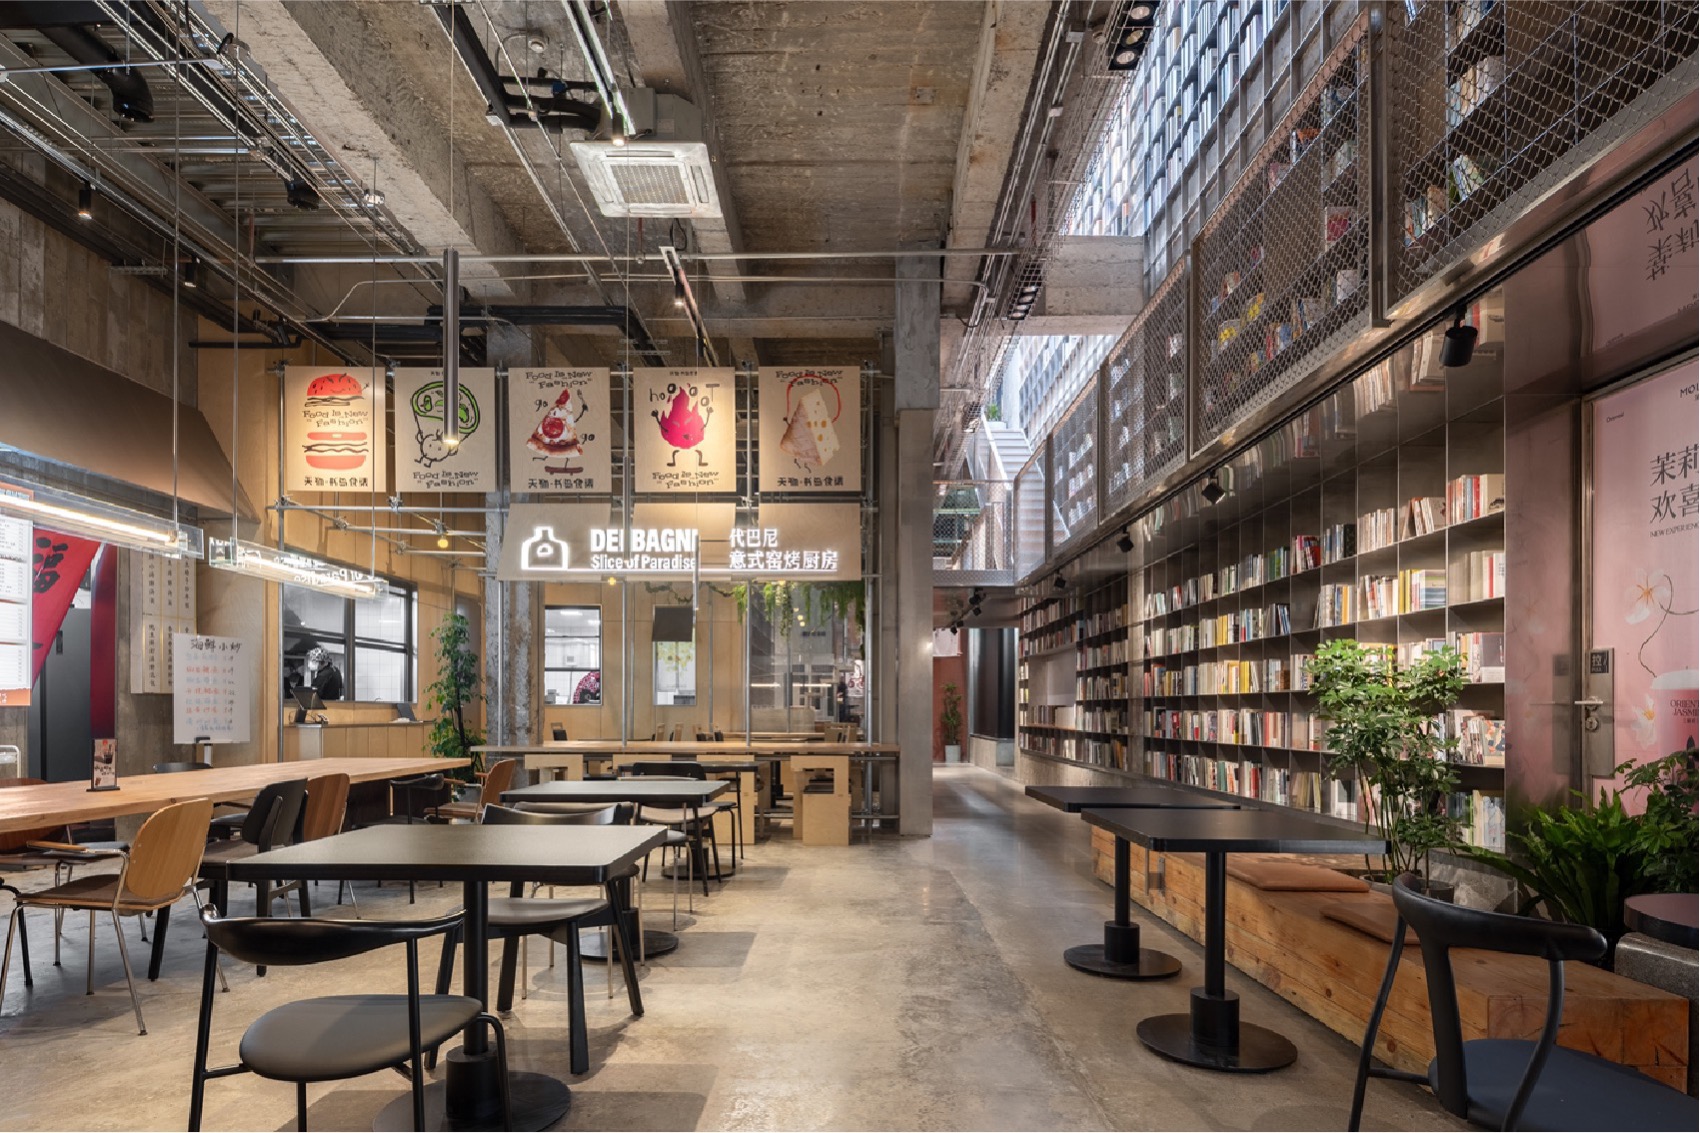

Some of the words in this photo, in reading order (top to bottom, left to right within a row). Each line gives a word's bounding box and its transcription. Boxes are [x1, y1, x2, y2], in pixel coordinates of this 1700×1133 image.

[301, 410, 329, 418] Food
[412, 471, 439, 480] Food
[652, 471, 680, 480] Food
[1650, 483, 1699, 524] 欢喜
[630, 528, 699, 553] BAGNI
[729, 528, 778, 548] 代巴尼
[590, 553, 624, 570] Slice
[641, 553, 696, 570] Paradise
[729, 550, 839, 570] 意式窑烤厨房
